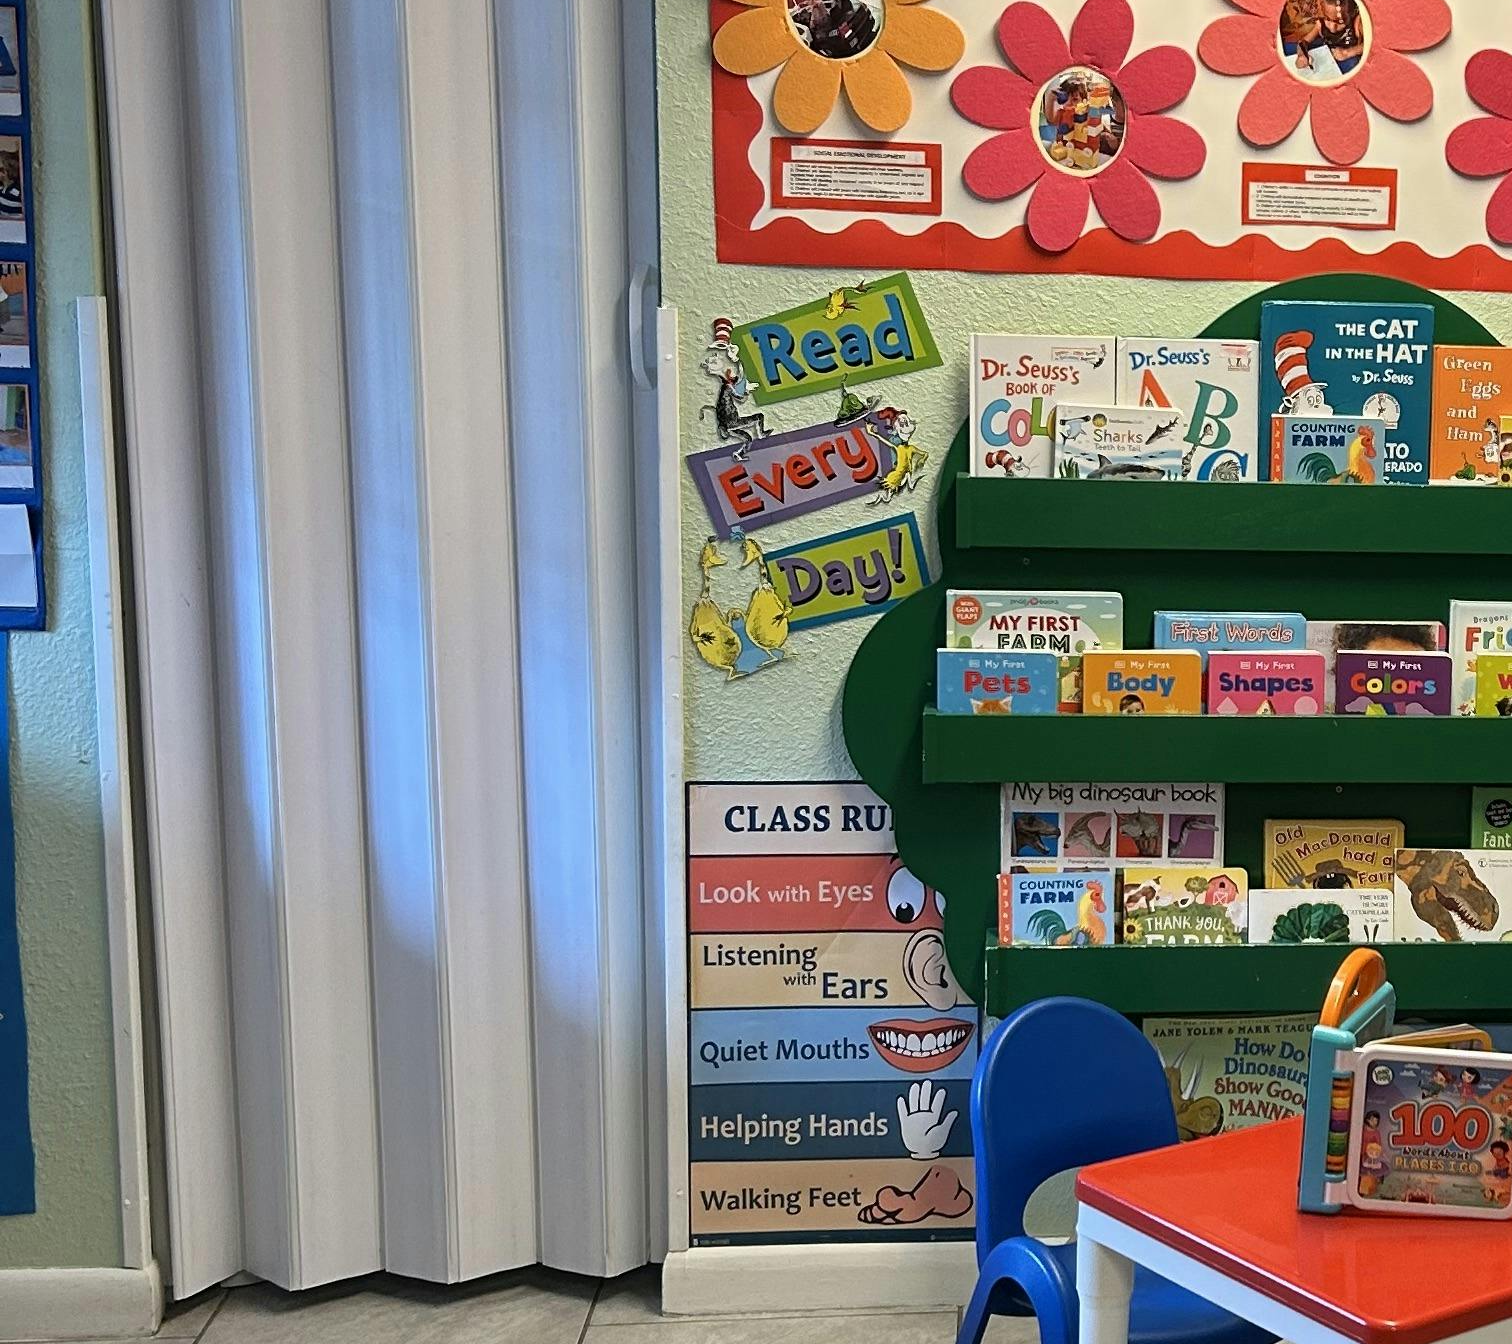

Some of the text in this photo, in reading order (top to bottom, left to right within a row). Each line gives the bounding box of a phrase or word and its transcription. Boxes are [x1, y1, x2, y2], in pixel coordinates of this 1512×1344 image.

[1335, 319, 1419, 340] THE CAT
[749, 295, 915, 386] Read
[1129, 346, 1210, 371] Dr. Seuss's
[1325, 344, 1428, 364] IN THE HAT
[1443, 356, 1493, 372] Green
[981, 355, 1080, 385] Dr. Seuss's
[1362, 369, 1414, 386] Dr. Seuss
[1006, 382, 1056, 397] BOOK OF
[1460, 379, 1501, 400] Eggs
[1447, 405, 1477, 419] and
[1093, 429, 1143, 444] Sharks
[1291, 423, 1356, 434] COUNTING
[1446, 426, 1484, 442] Ham
[1292, 435, 1346, 447] FARM
[718, 424, 879, 518] Every
[777, 528, 905, 606] Day!
[989, 615, 1081, 632] MY FIRST
[1473, 614, 1508, 625] Dragons
[1170, 621, 1293, 643] First Words
[984, 659, 1026, 670] My First
[963, 670, 1032, 694] Pets
[1107, 672, 1175, 697] Body
[1218, 672, 1314, 700] Shapes
[1350, 672, 1437, 695] Colors
[1012, 783, 1217, 805] My big dinosaur book
[723, 805, 831, 833] CLASS
[1275, 825, 1304, 846] Old
[1296, 832, 1391, 858] MacDonald
[1343, 847, 1394, 866] had a
[699, 879, 874, 908] Look with Eyes
[1019, 879, 1084, 890] COUNTING
[1020, 891, 1075, 904] FARM
[1145, 917, 1226, 932] THANK YOU,
[703, 945, 818, 971] Listening
[783, 971, 888, 1000] with Ears
[1153, 1025, 1270, 1037] JANE YOLEN MARK
[699, 1036, 870, 1069] Quiet Mouths
[1234, 1037, 1305, 1062] How Do
[1215, 1077, 1264, 1095] Show
[700, 1111, 889, 1145] Helping Hands
[1388, 1100, 1493, 1151] 100
[1403, 1147, 1470, 1159] Words About
[1395, 1158, 1445, 1170] PLACES
[1459, 1161, 1479, 1172] GO
[700, 1186, 862, 1215] Walking Feet
